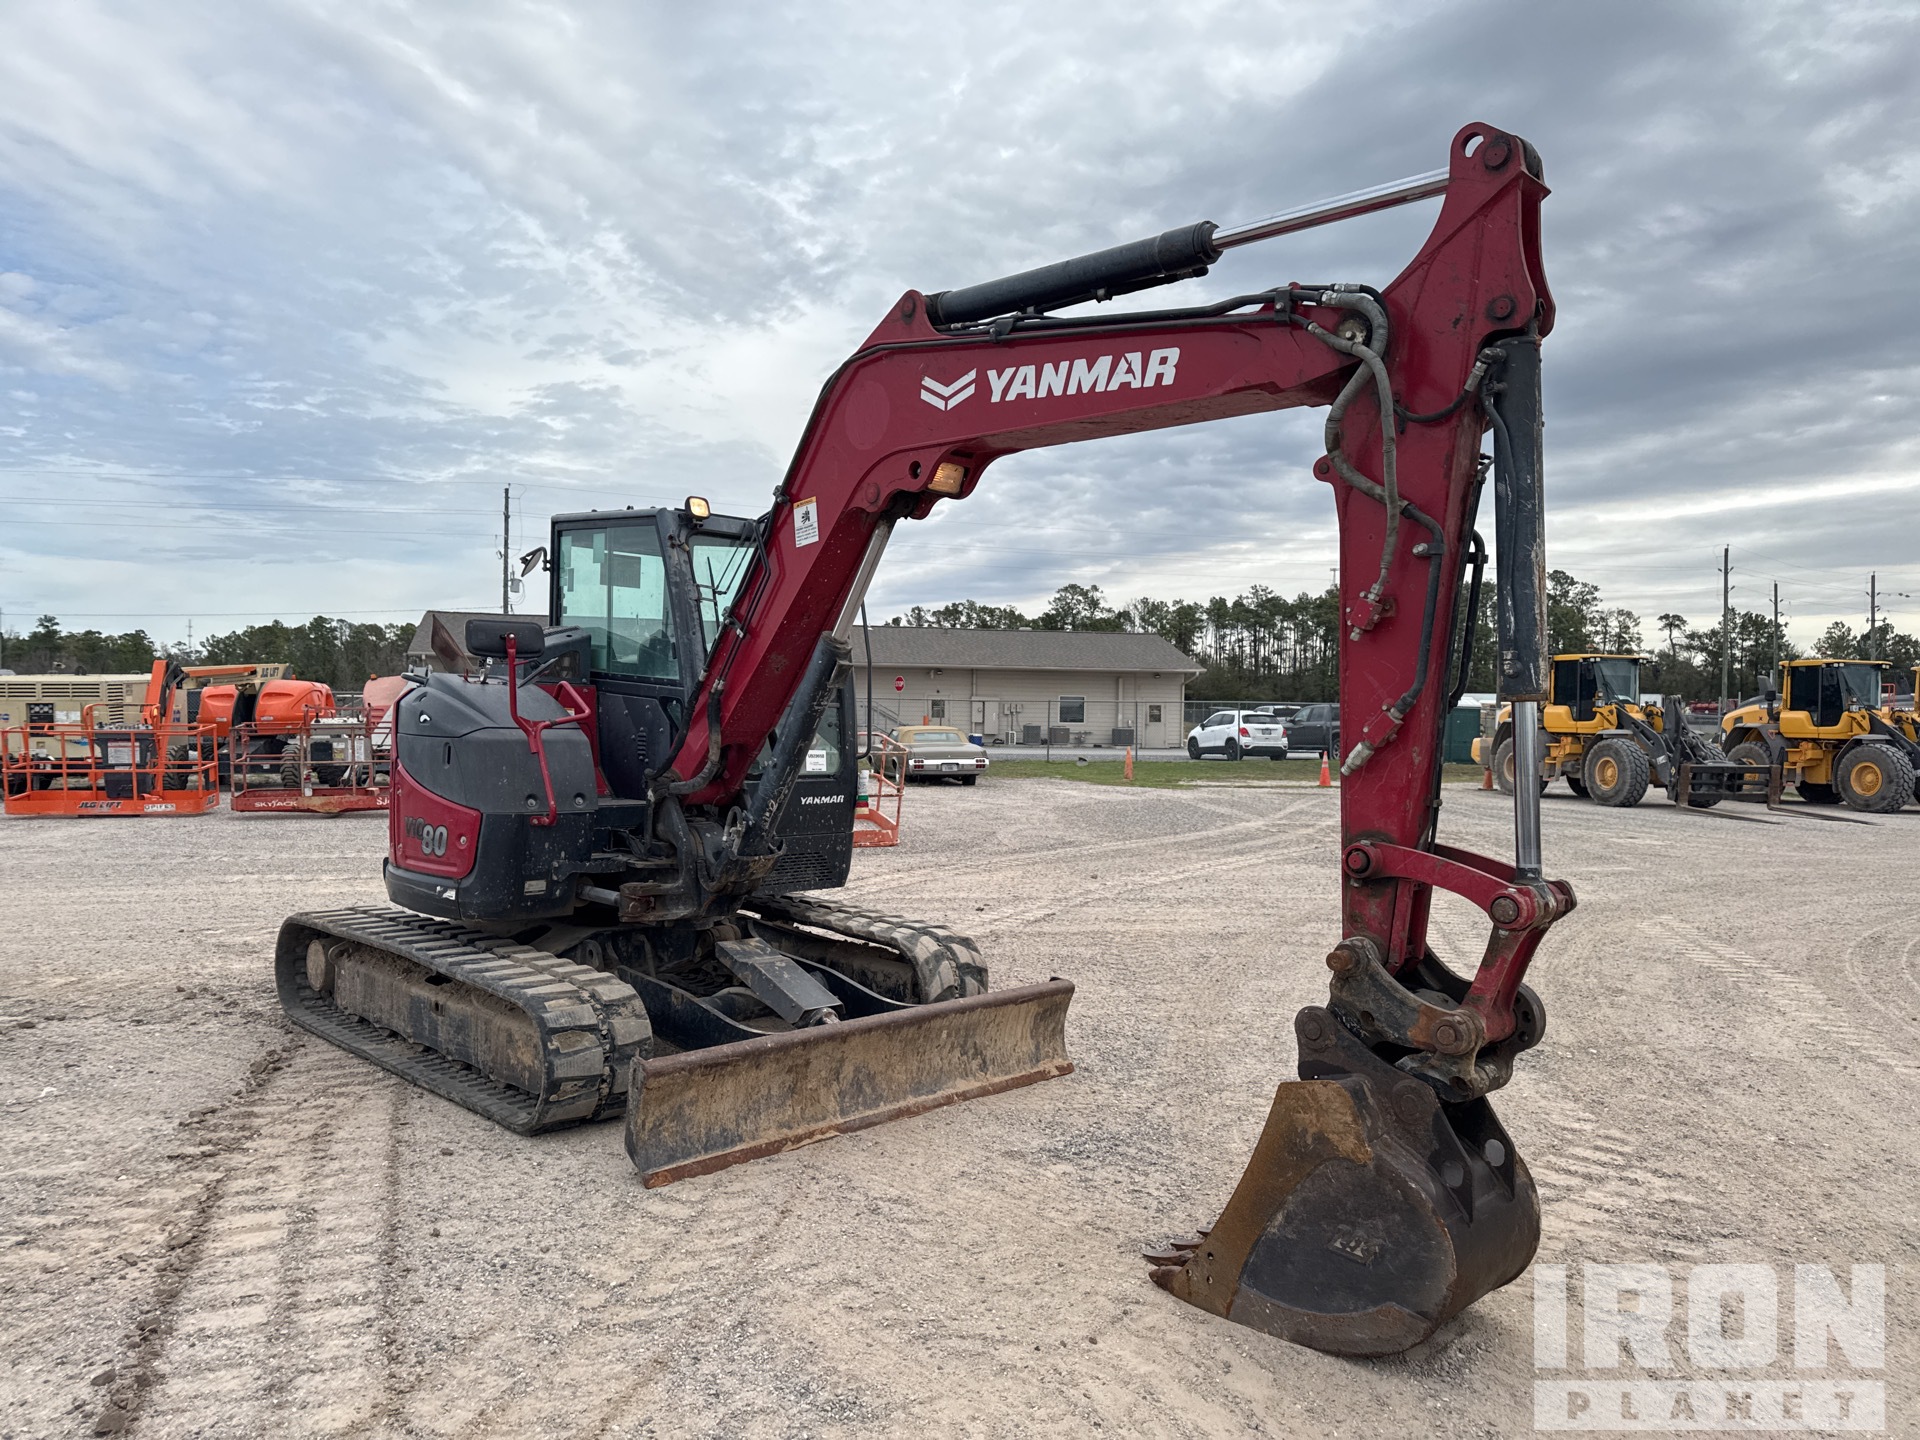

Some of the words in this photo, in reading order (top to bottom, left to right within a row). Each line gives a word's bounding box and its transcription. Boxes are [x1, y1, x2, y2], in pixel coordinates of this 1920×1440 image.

[986, 347, 1180, 403] YANMAR
[78, 801, 98, 809] JLG
[99, 801, 122, 809] LIFT
[254, 799, 298, 808] SKYJACK
[376, 796, 390, 806] SJ
[800, 795, 845, 805] YANMAR
